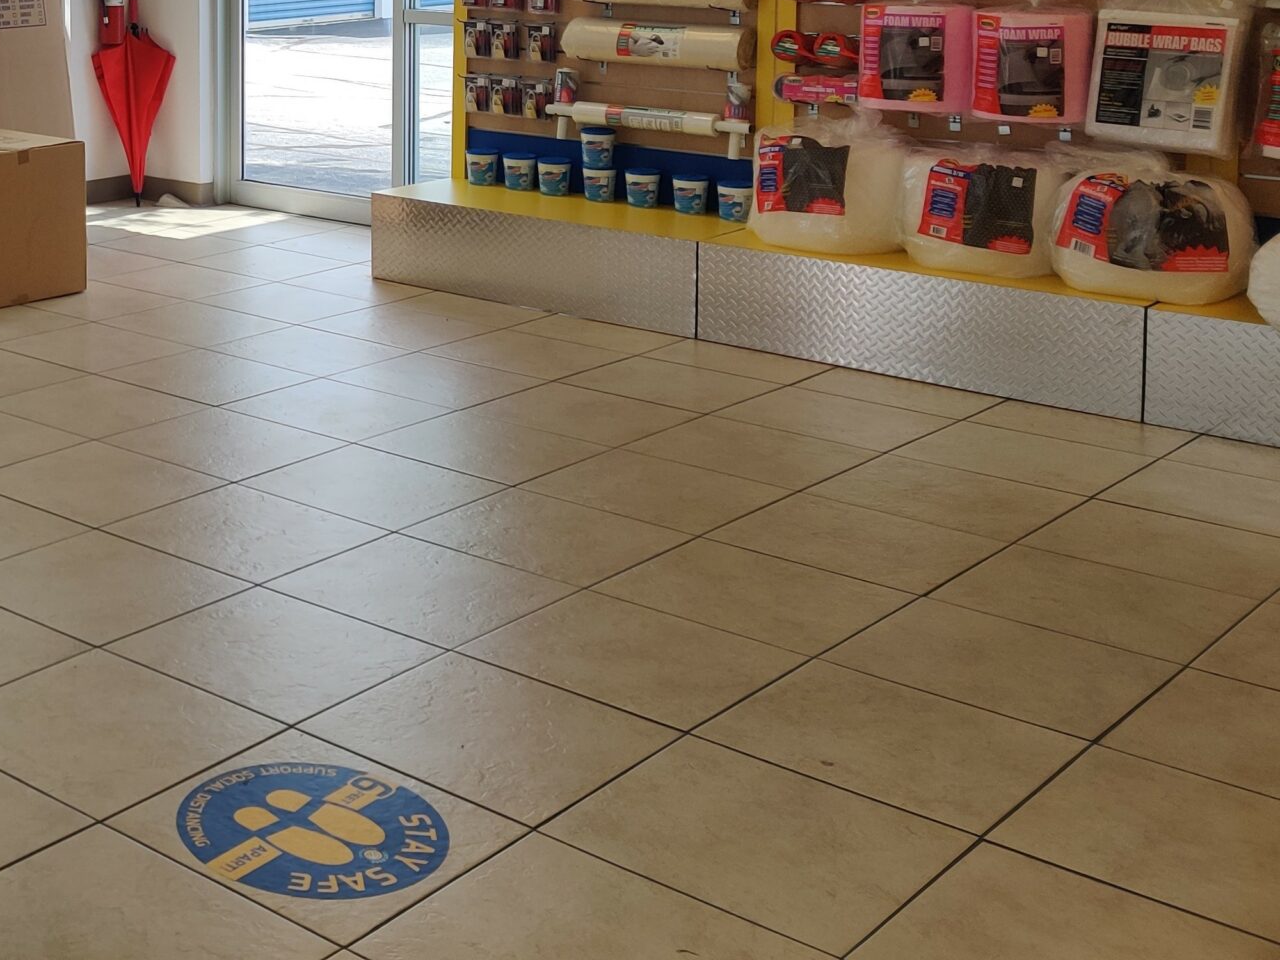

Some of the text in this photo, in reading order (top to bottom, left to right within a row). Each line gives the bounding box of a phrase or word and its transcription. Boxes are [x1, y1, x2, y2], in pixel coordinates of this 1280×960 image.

[884, 16, 943, 27] FOAM WRAP
[999, 28, 1061, 40] FOAM WRAP
[1107, 32, 1223, 52] BUBBLE WRAP BAGS
[185, 765, 337, 848] SUPPORT SOCIAL DISTANCING
[341, 790, 368, 806] FEET
[223, 843, 270, 873] APART!
[286, 813, 438, 895] STAY SAFE
